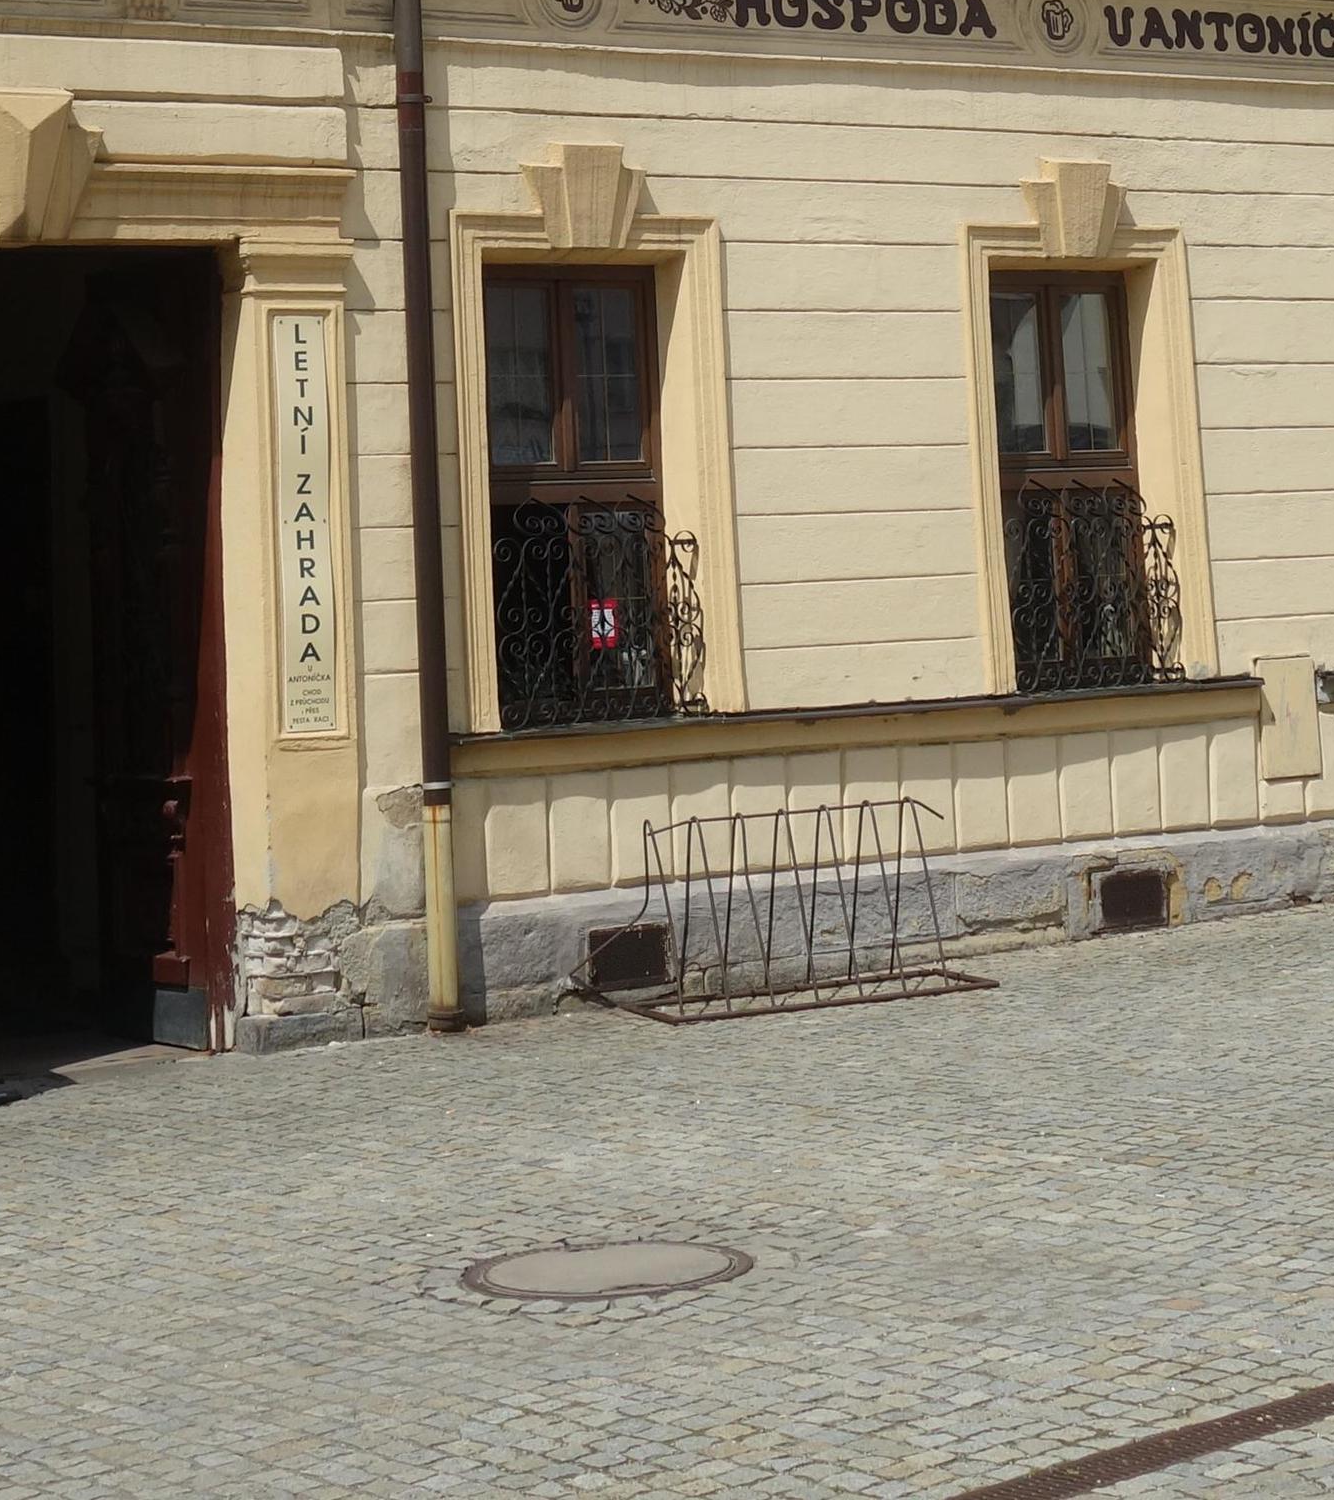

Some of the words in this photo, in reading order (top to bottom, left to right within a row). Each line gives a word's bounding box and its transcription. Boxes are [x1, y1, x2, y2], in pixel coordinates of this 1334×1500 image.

[1103, 4, 1135, 47] U
[293, 323, 313, 455] LETNÍ
[294, 473, 321, 663] ZAHRADA
[288, 672, 331, 683] ANTONÍČKA
[307, 664, 313, 672] U
